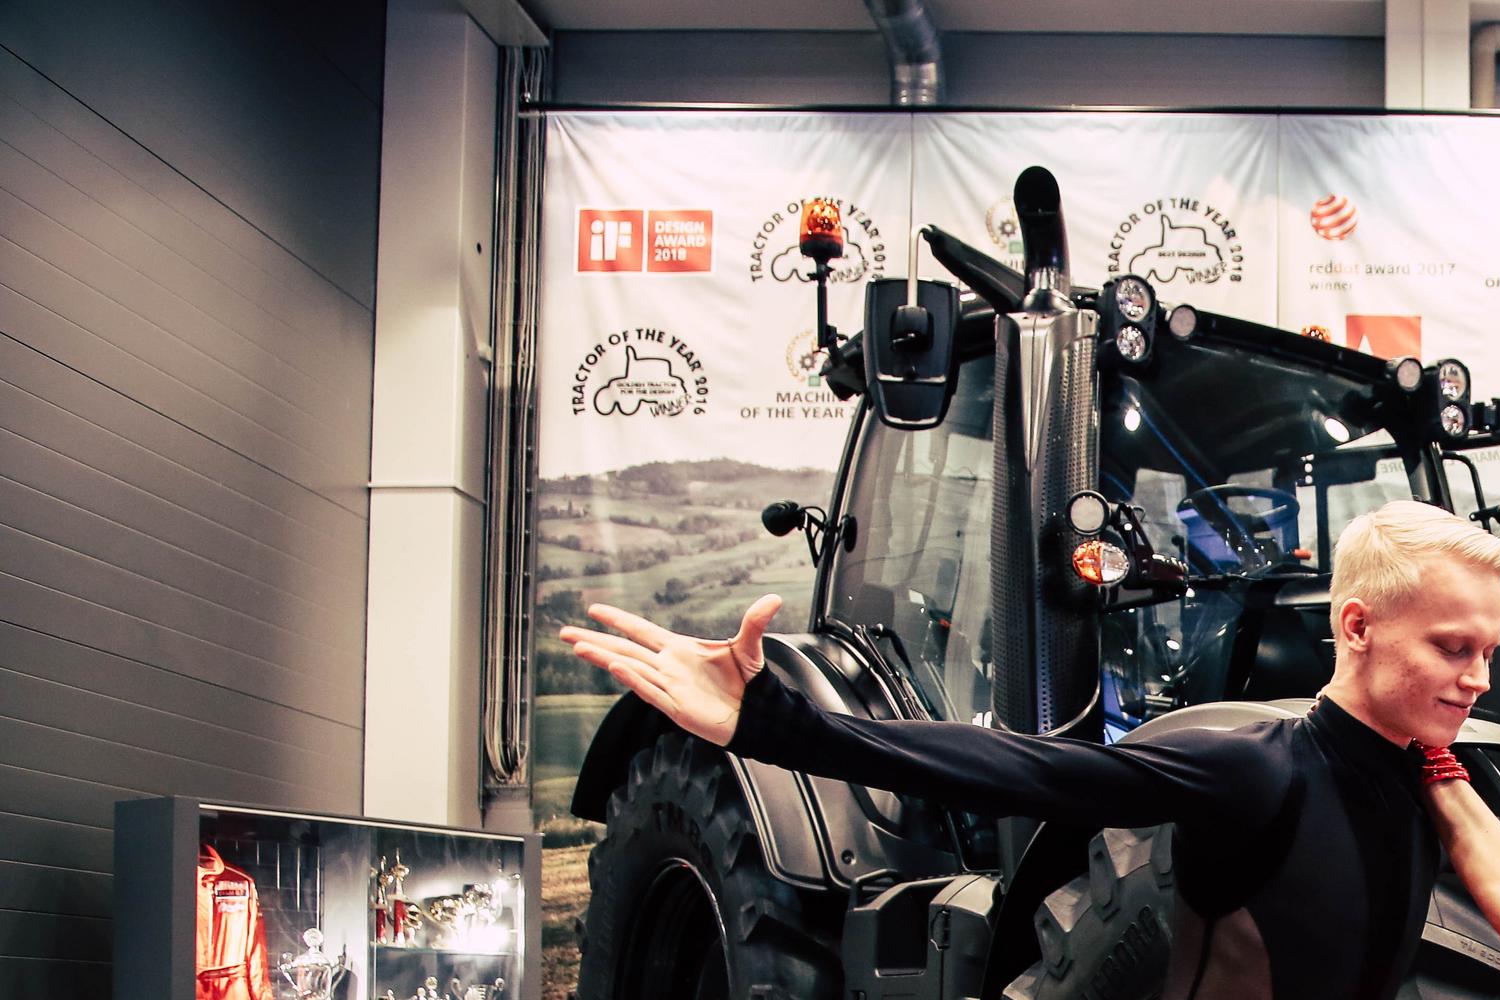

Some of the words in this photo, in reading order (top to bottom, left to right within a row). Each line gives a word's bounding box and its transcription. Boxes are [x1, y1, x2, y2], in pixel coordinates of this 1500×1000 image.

[654, 221, 705, 234] DESIGN
[654, 234, 706, 248] AWARD
[750, 213, 784, 282] TRACTOR
[848, 204, 880, 239] YEAR
[1108, 213, 1141, 276] RACTOR
[1144, 200, 1162, 215] OF
[1170, 198, 1200, 212] THE
[1204, 205, 1236, 240] YEAR
[1230, 245, 1244, 282] 2018
[654, 247, 687, 262] 2018
[1364, 261, 1411, 275] award
[1416, 262, 1457, 276] 2017
[1309, 280, 1353, 291] winner
[572, 344, 606, 415] TRACTOR
[608, 330, 629, 345] OF
[636, 328, 666, 343] THE
[669, 335, 704, 372] YEAR
[693, 376, 709, 415] 2016
[776, 391, 837, 403] MACHI
[740, 407, 760, 418] OF
[766, 407, 795, 418] THE
[801, 407, 844, 418] YEAR
